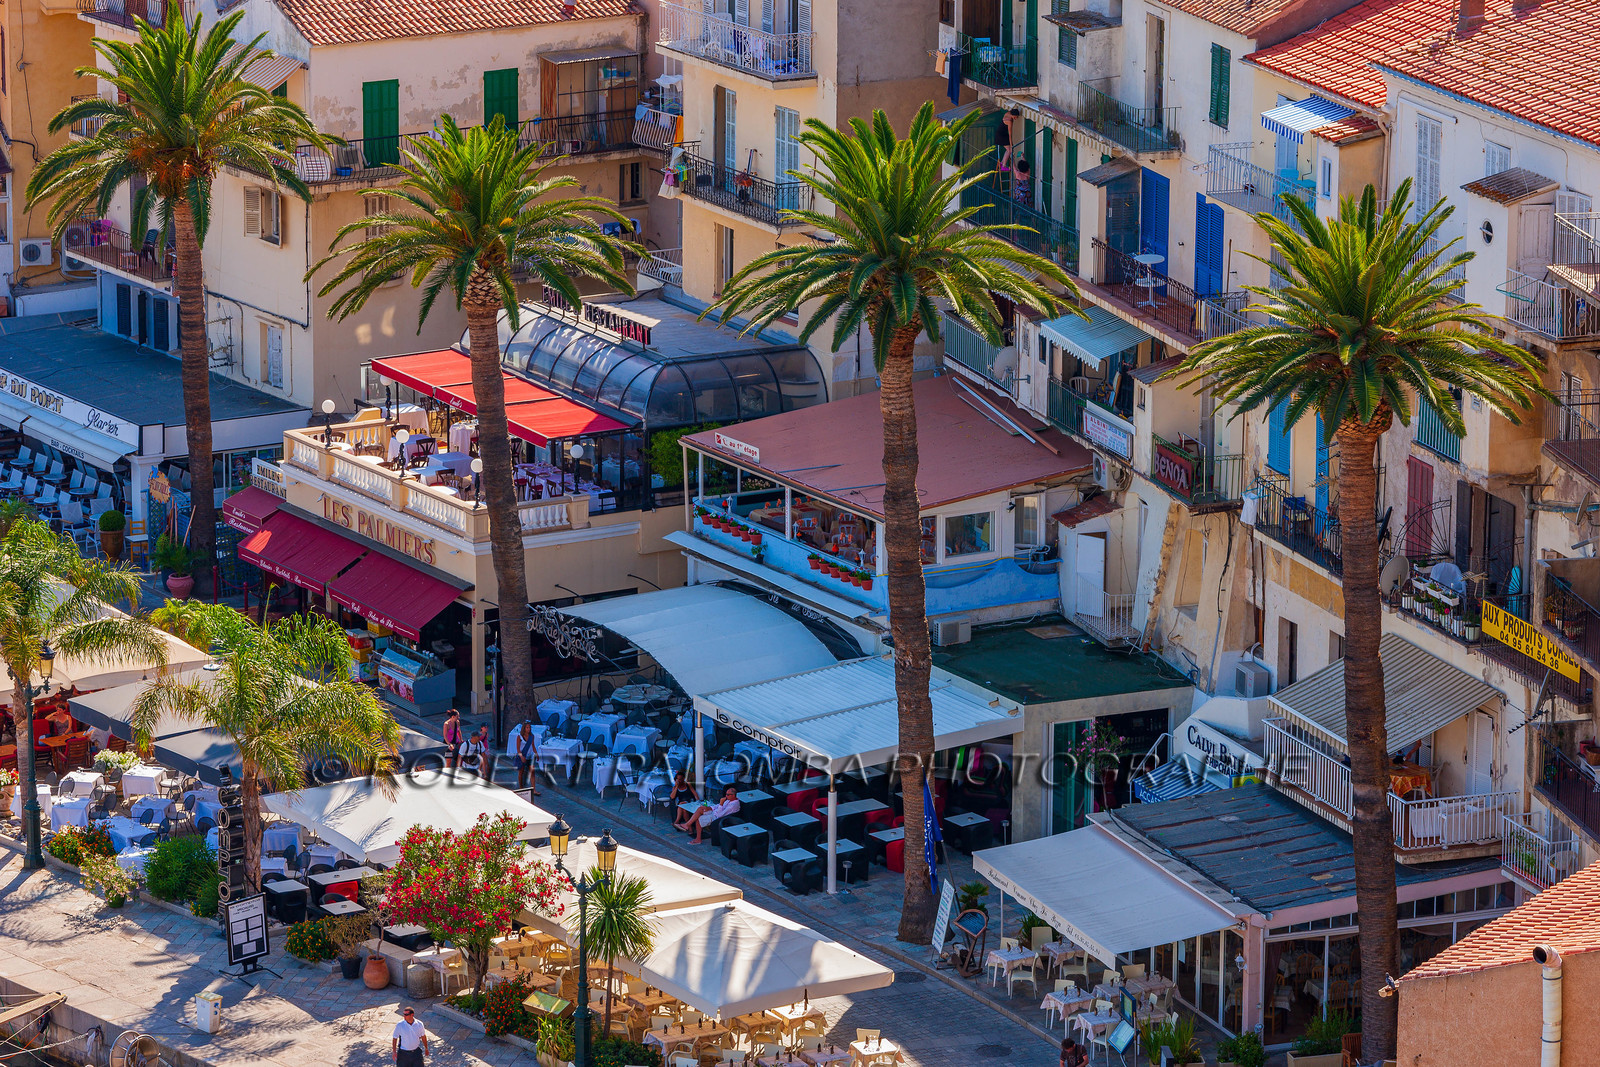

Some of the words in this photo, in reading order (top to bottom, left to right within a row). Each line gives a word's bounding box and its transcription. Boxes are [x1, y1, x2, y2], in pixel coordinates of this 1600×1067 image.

[584, 302, 652, 345] RESTAURANT
[30, 386, 64, 414] PORT
[51, 440, 60, 450] BAR
[62, 445, 85, 460] COCKTAILS
[322, 493, 353, 529] LES
[357, 509, 437, 566] PALMIERS
[1483, 602, 1500, 628] AUX
[1503, 612, 1544, 650] PRODUITS
[1499, 630, 1509, 643] 04
[1512, 638, 1522, 650] 95
[1525, 645, 1534, 657] 61
[1536, 653, 1546, 663] 54
[1549, 657, 1559, 670] 36
[716, 708, 729, 724] le
[732, 719, 802, 760] comptoir
[1187, 724, 1216, 758] CALVI
